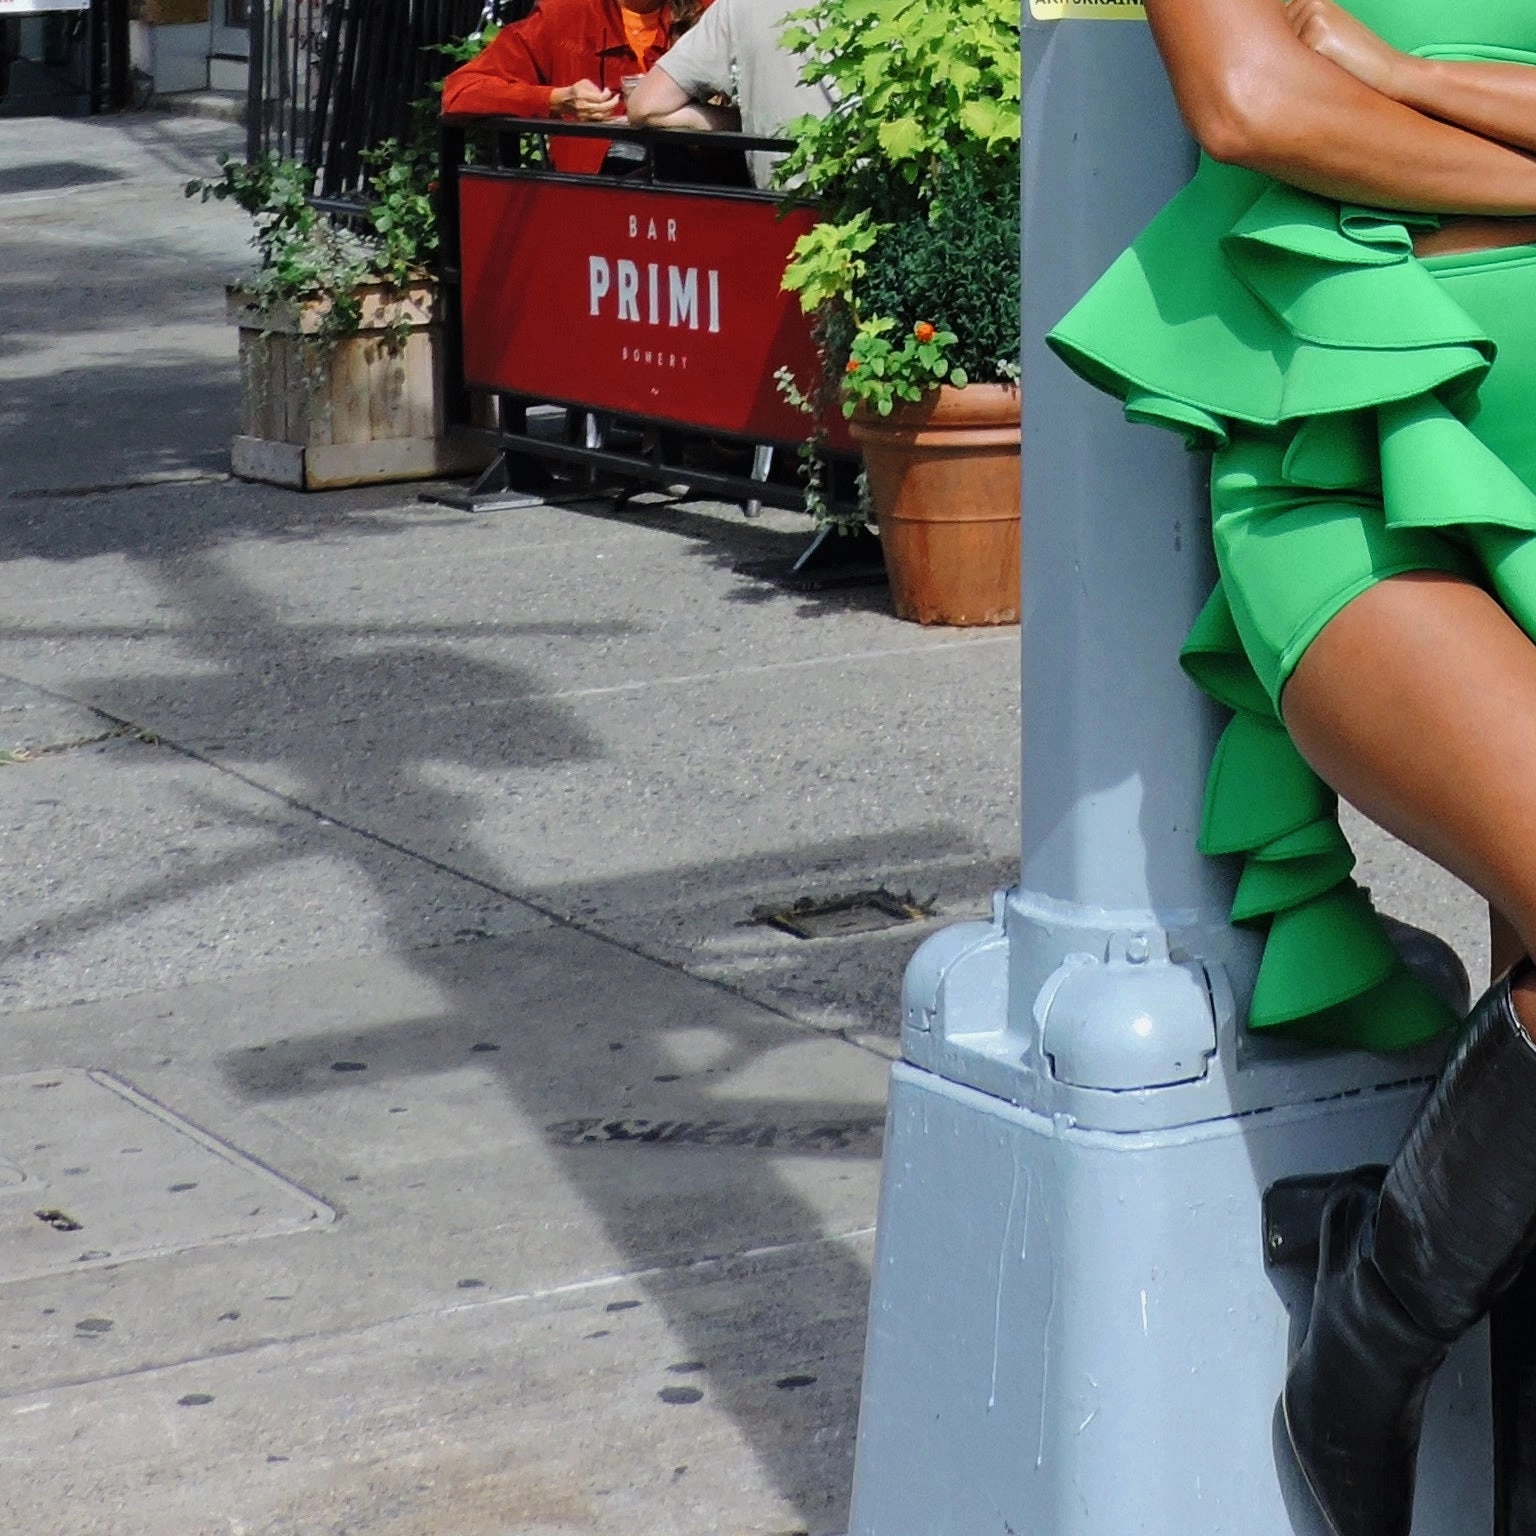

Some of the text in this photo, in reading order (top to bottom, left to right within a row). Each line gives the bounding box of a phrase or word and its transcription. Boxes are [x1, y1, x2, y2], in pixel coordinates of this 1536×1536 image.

[629, 214, 677, 242] BAR
[589, 255, 720, 333] PRIMI
[622, 346, 688, 369] BOWERY
